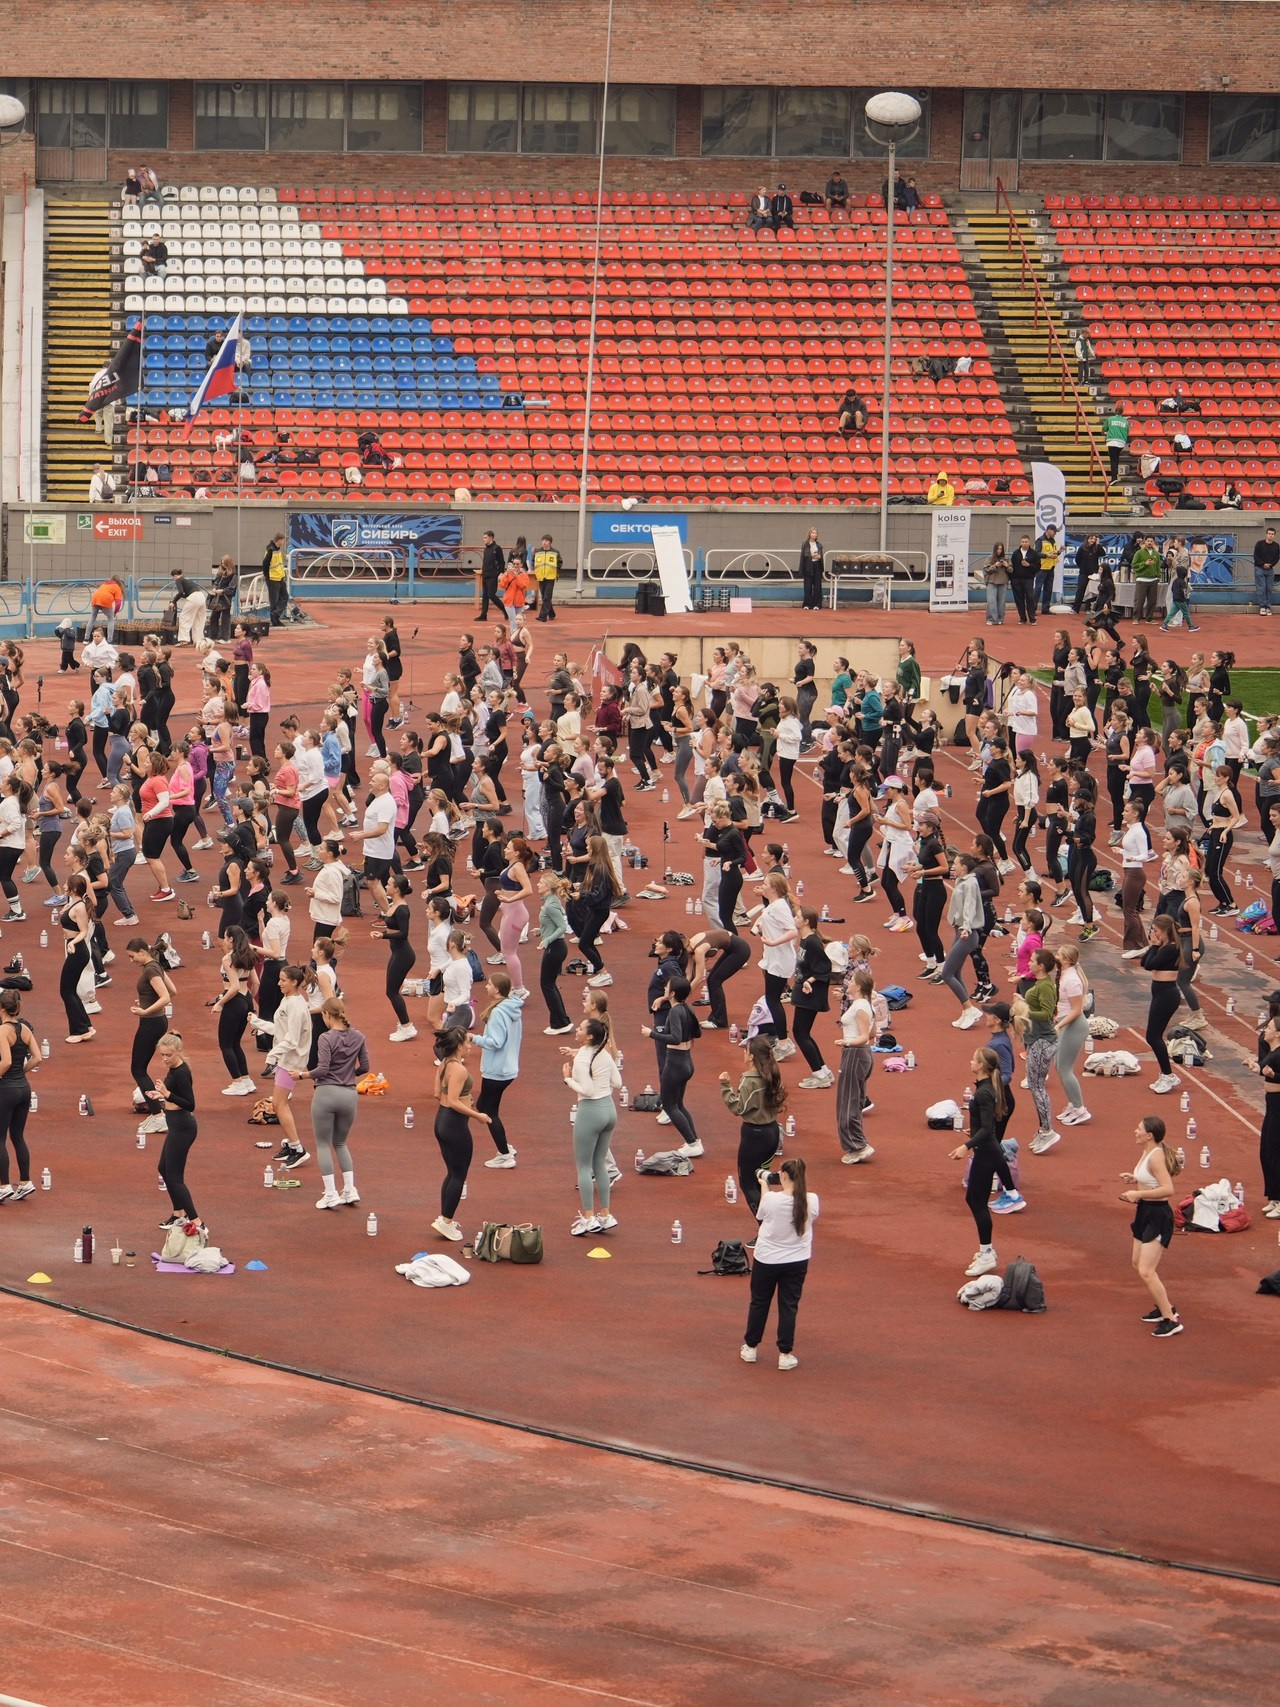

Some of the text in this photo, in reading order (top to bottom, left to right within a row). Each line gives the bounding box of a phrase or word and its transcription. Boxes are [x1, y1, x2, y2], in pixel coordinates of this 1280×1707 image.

[108, 517, 141, 526] ВЫХОД
[937, 514, 966, 522] kolsa
[610, 524, 656, 533] СЕКТО
[361, 530, 418, 539] СИБИРЬ
